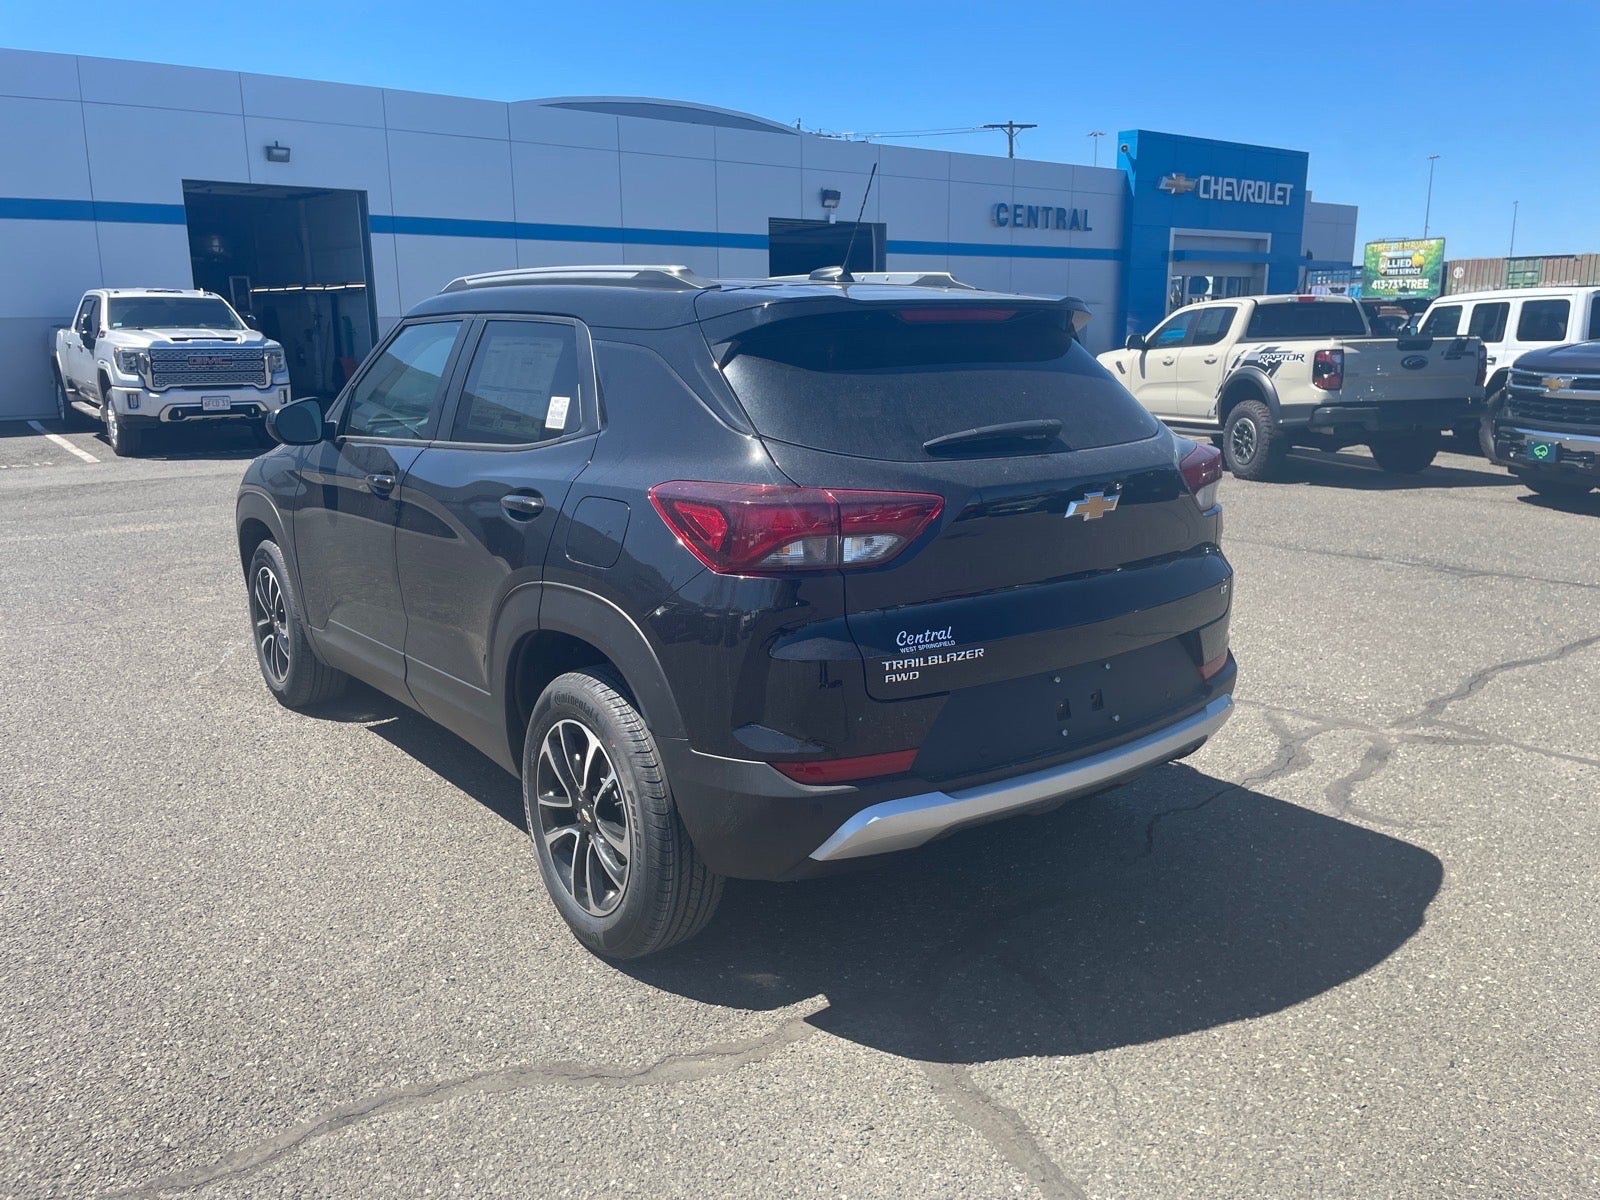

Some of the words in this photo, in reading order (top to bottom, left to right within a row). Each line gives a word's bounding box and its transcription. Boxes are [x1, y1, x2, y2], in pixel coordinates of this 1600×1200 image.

[1199, 175, 1294, 206] CHEVROLET
[993, 202, 1093, 232] CENTRAL
[1386, 268, 1398, 276] TREE
[1399, 267, 1421, 275] SERVICE
[188, 356, 232, 365] GMC
[1258, 353, 1305, 364] RAPTOR
[896, 626, 953, 646] Central
[900, 645, 917, 654] WEST
[918, 640, 956, 651] SPRINGFIELD
[882, 648, 985, 671] TRAILBLAZER
[885, 671, 920, 683] AWD
[554, 690, 594, 718] Continental
